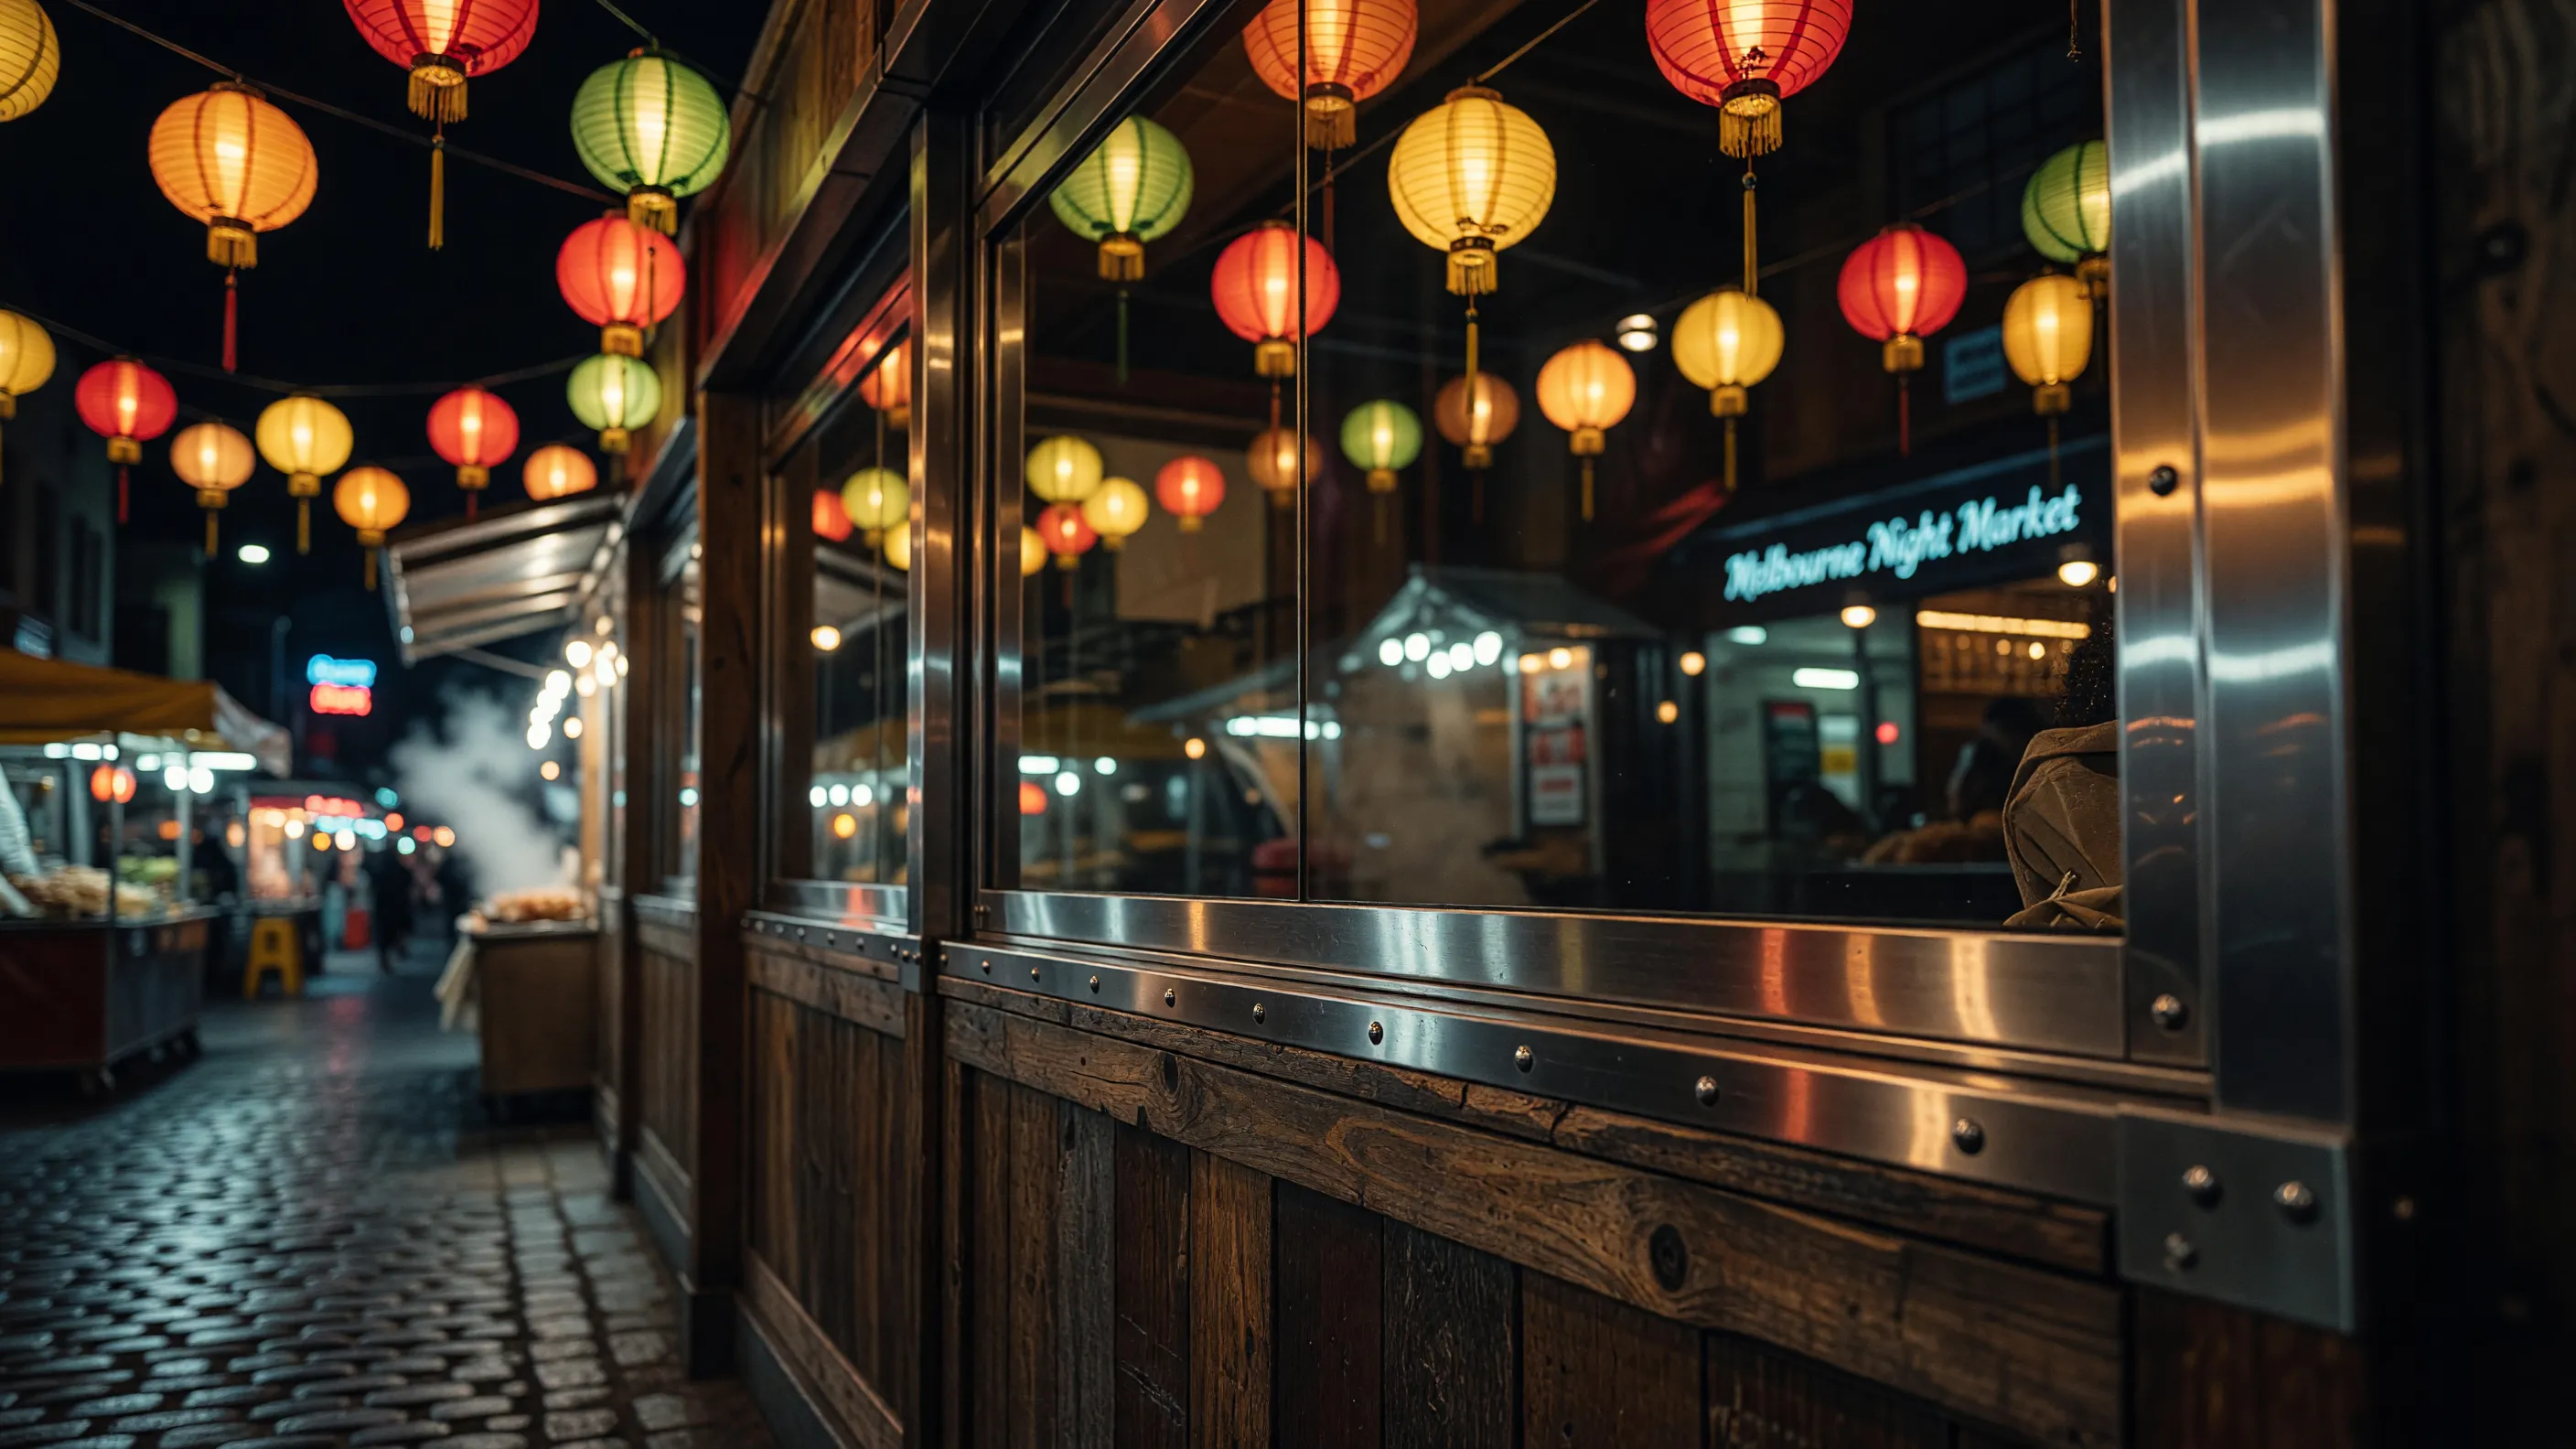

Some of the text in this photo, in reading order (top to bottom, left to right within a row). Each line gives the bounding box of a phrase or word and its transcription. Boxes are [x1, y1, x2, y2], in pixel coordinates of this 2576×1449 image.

[1723, 483, 2082, 603] Melbourne Night Market
